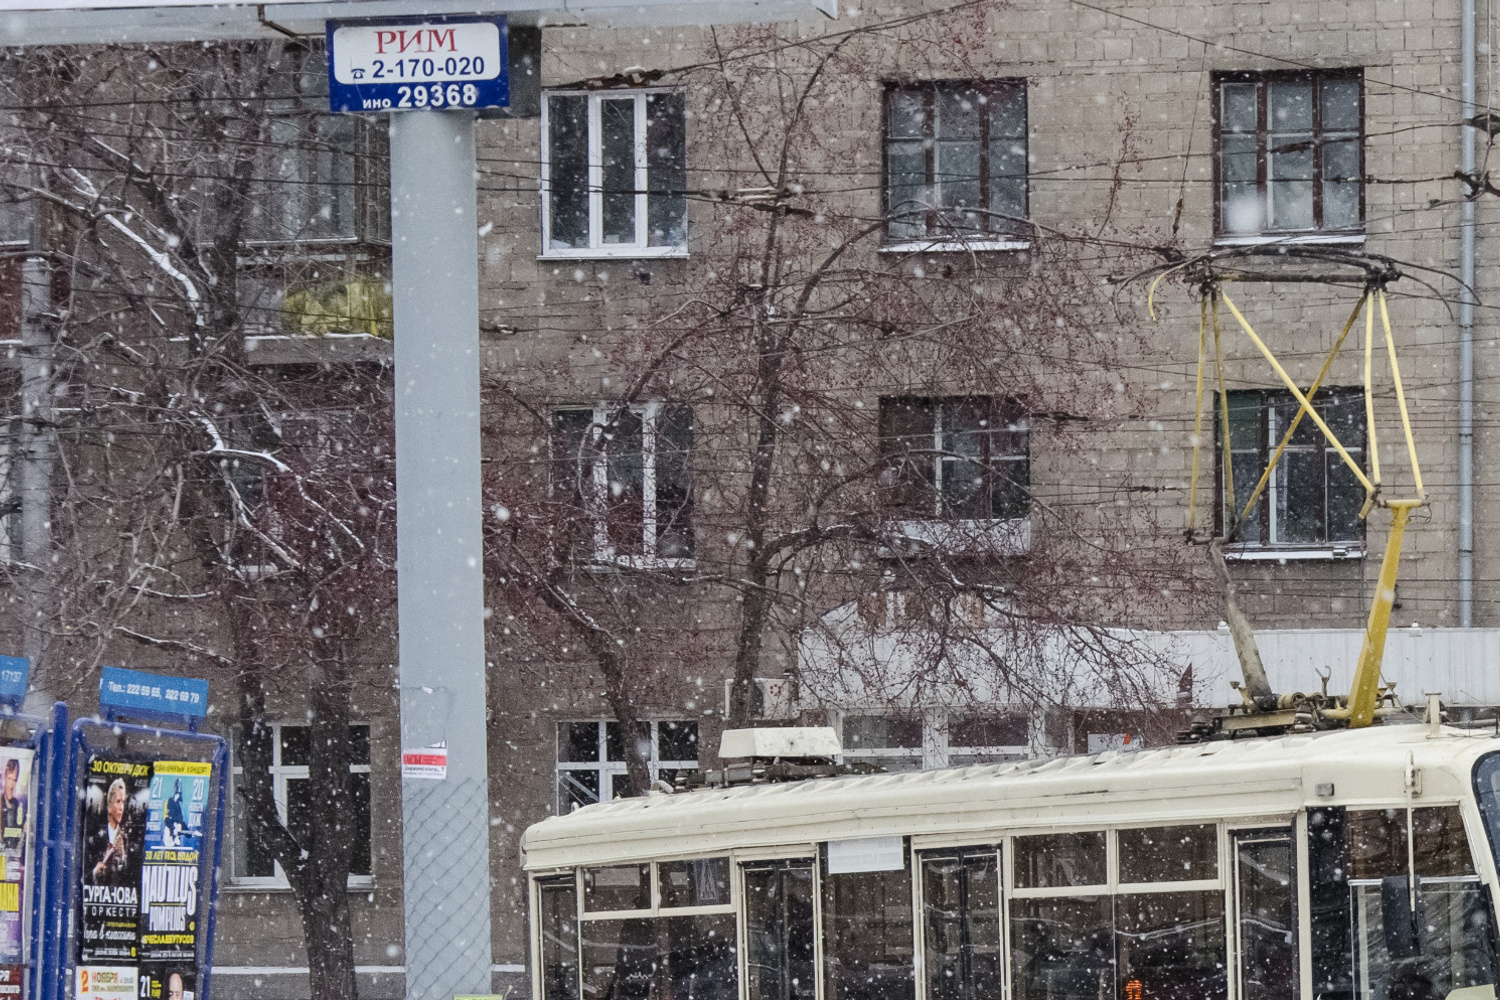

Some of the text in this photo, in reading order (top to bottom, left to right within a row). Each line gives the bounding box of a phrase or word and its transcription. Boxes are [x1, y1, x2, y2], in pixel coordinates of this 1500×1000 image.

[374, 28, 458, 54] РИМ
[372, 56, 485, 79] 2-170-020
[362, 84, 478, 110] ино 29368
[92, 760, 102, 772] 30
[152, 777, 162, 798] 21
[193, 779, 204, 800] 20
[92, 906, 137, 917] ОРКЕСТР
[81, 970, 88, 994] 2
[92, 972, 118, 983] НОЯБРЯ
[140, 976, 150, 998] 21
